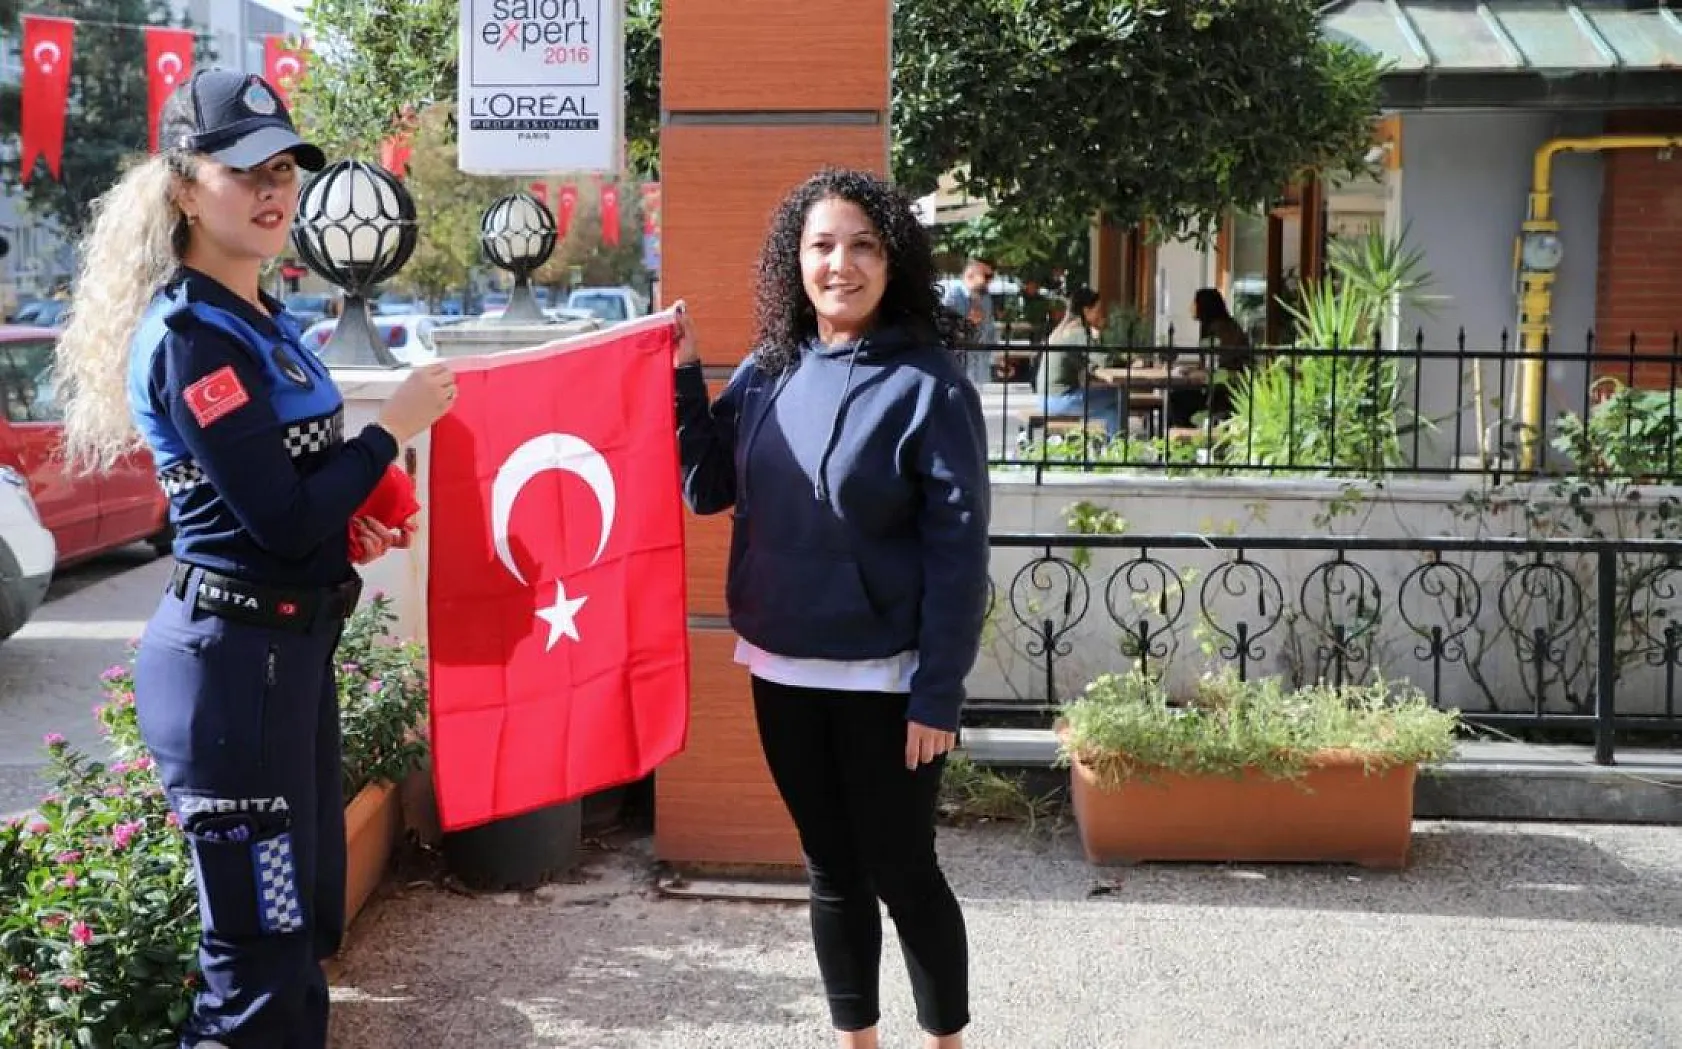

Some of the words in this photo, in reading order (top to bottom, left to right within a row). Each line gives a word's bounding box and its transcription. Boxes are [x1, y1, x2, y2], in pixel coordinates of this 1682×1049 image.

[493, 0, 580, 20] salon
[482, 16, 590, 52] expert
[544, 46, 590, 64] 2016
[470, 93, 600, 118] L'ORÉAL
[181, 796, 290, 813] ZABITA
